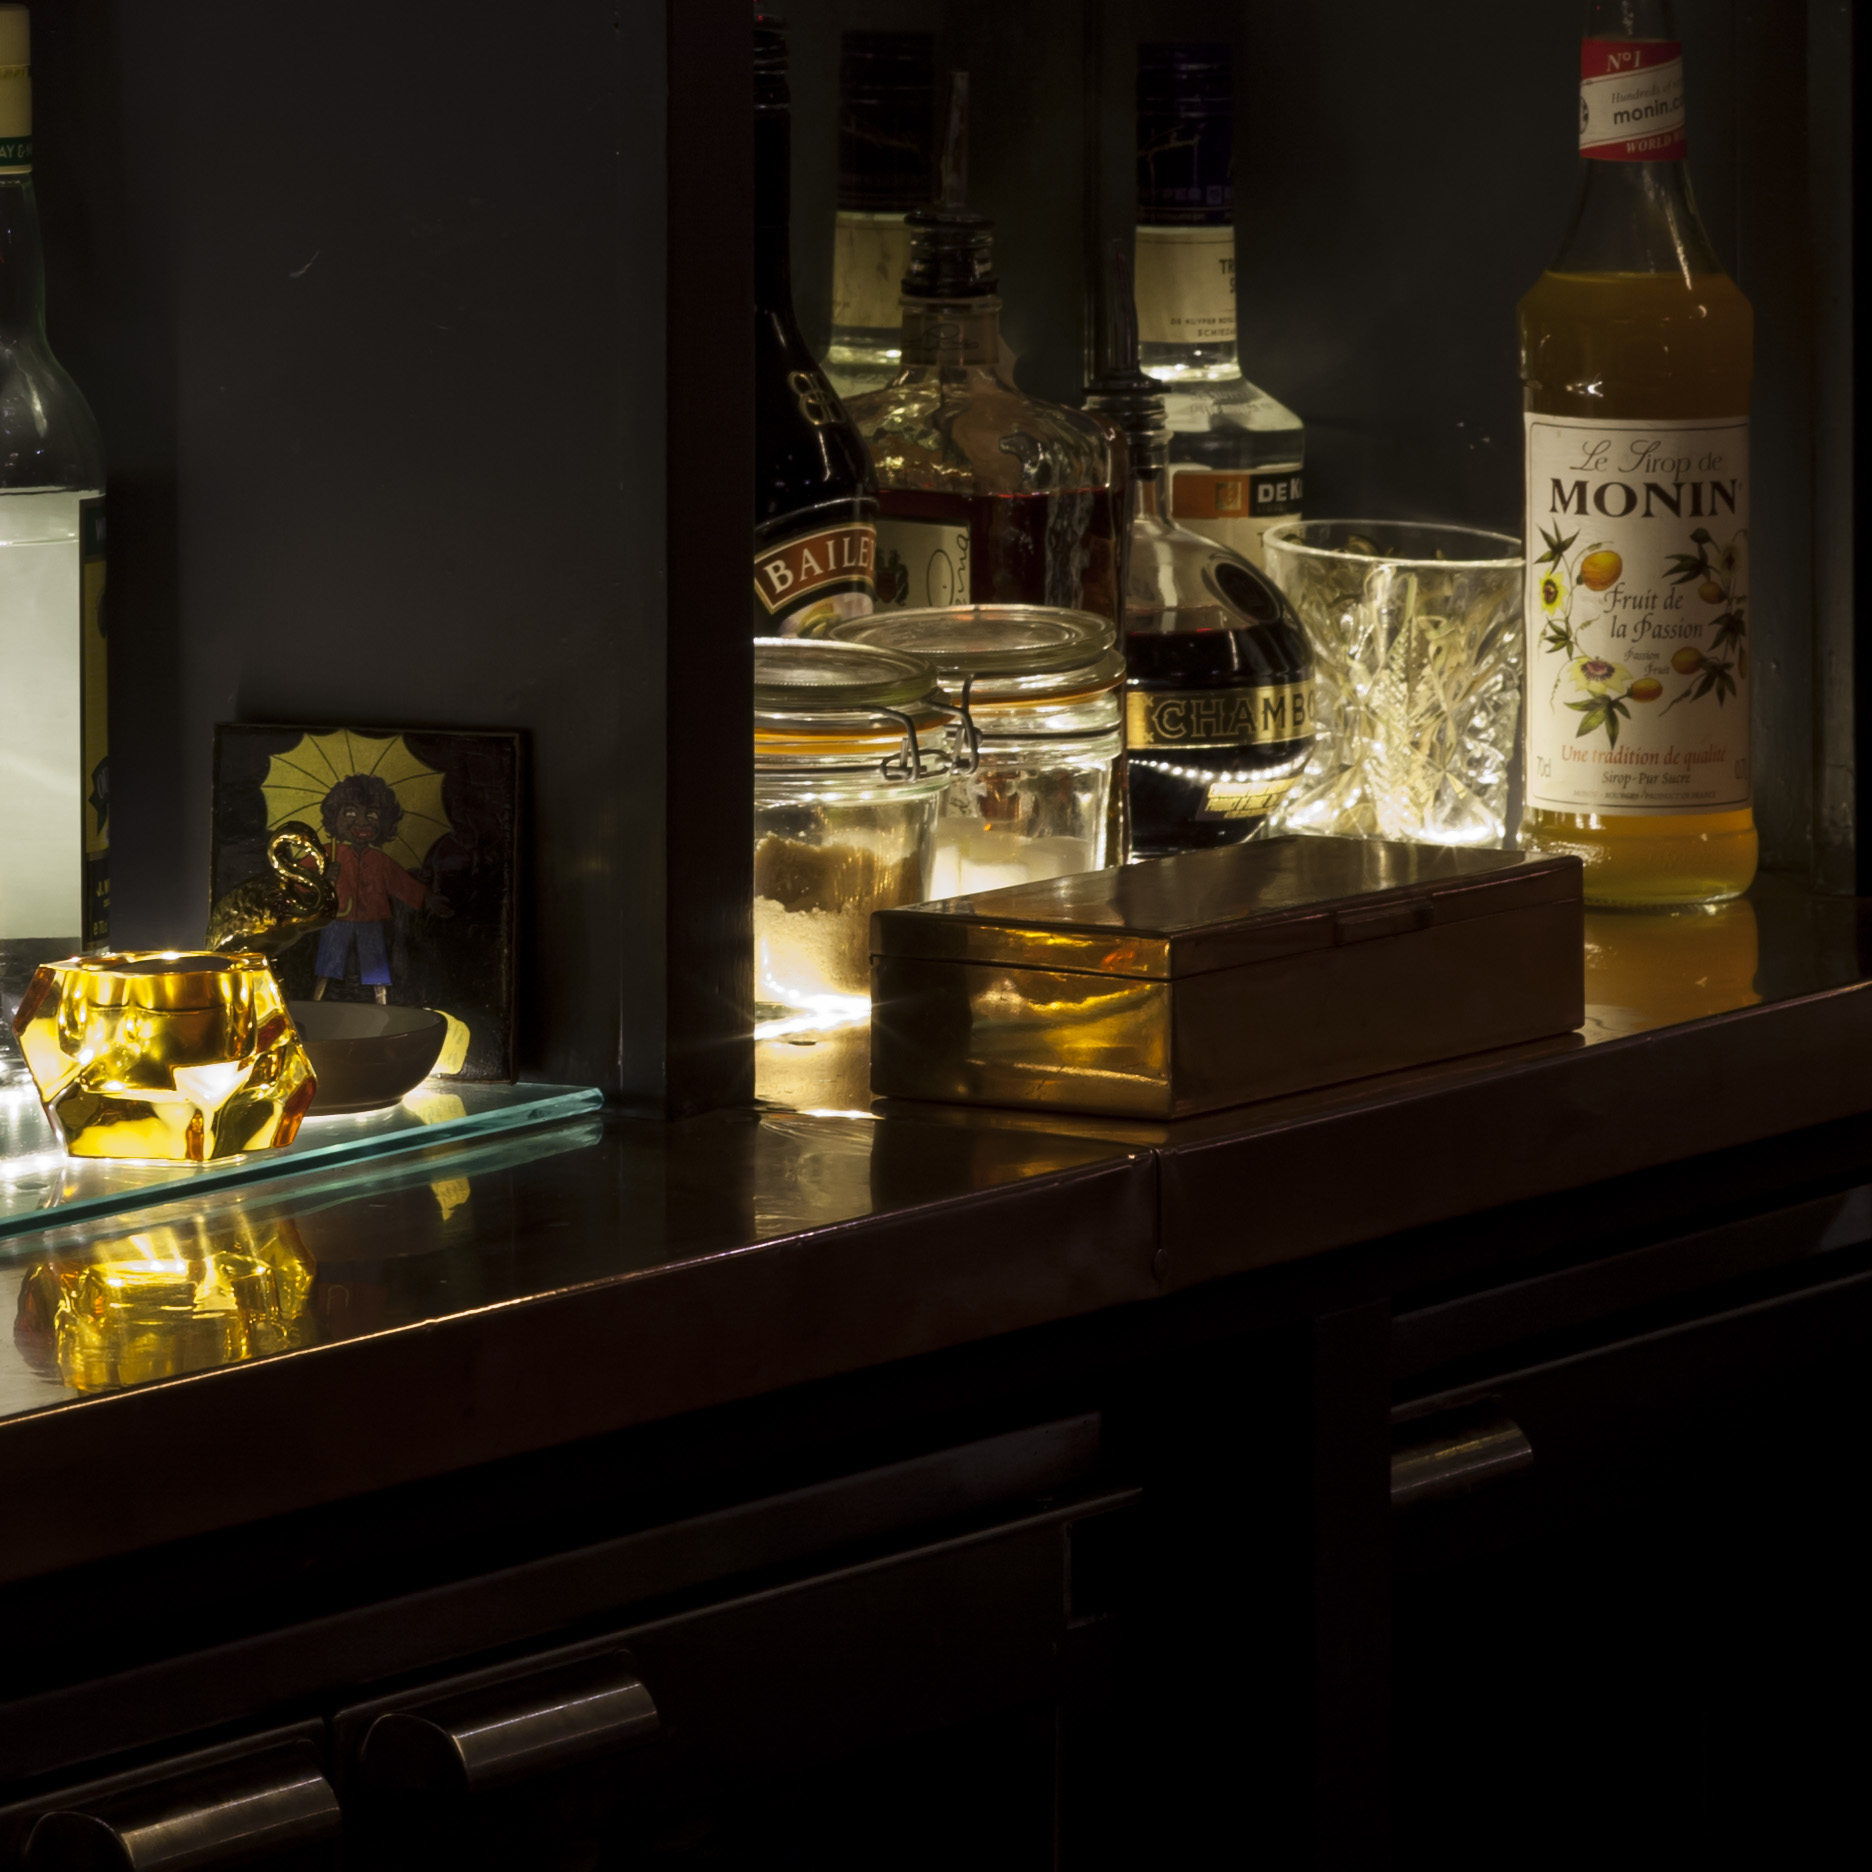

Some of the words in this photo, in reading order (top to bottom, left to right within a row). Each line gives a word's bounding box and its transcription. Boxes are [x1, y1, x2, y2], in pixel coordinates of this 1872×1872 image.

[1611, 82, 1660, 105] Hundreds
[1626, 135, 1673, 154] WORLD
[1569, 439, 1612, 472] Le
[1618, 439, 1692, 483] Sirop
[1698, 451, 1723, 472] de
[1549, 477, 1739, 519] MONIN
[1603, 581, 1659, 614] Fruit
[1663, 587, 1684, 611] de
[1631, 612, 1704, 644] Passion
[1536, 755, 1553, 778] 70cl
[1560, 744, 1589, 763] Une
[1591, 745, 1660, 766] tradition
